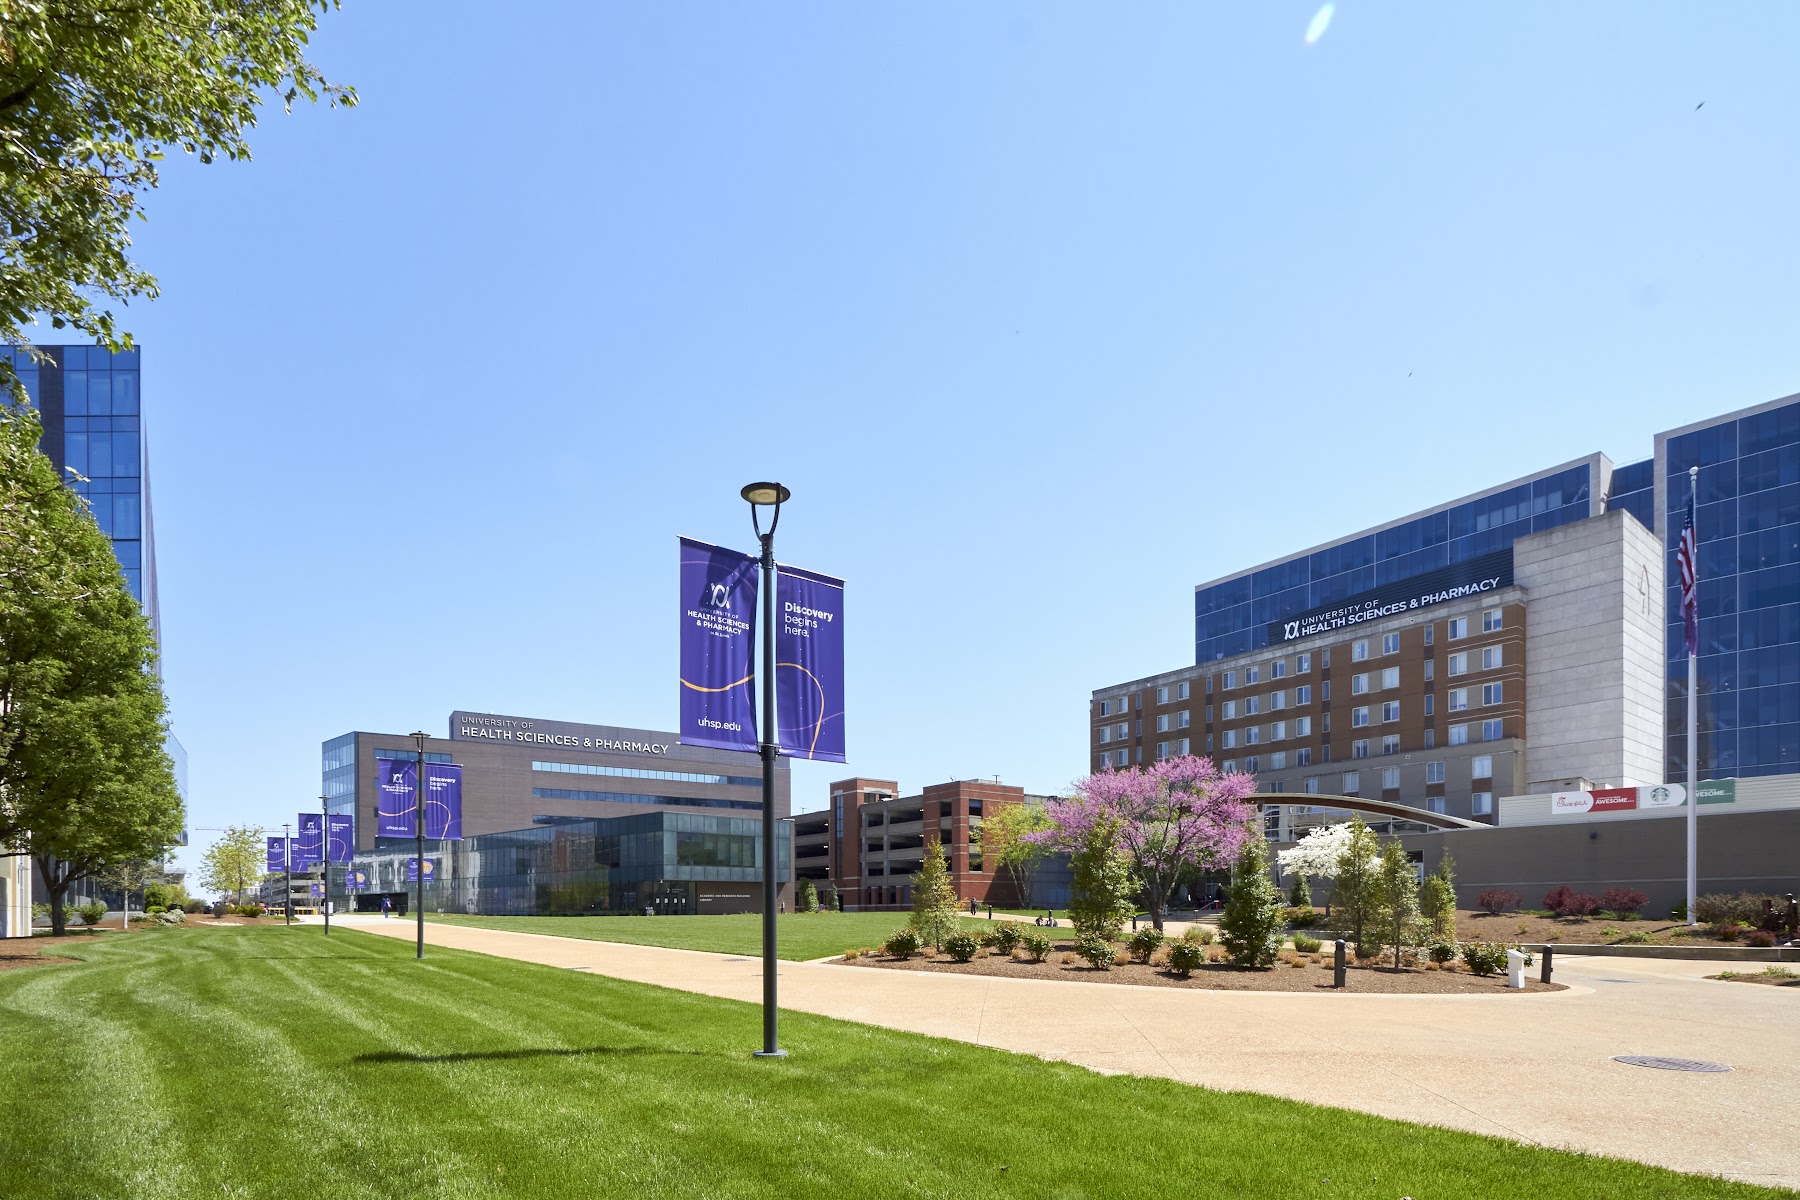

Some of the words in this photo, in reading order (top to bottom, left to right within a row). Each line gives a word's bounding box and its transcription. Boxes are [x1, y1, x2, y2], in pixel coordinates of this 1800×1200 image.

[784, 601, 834, 623] Discovery
[1301, 618, 1347, 637] HEALTH
[1347, 601, 1407, 625] SCIENCES
[1409, 598, 1420, 610] &
[1421, 576, 1501, 608] PHARMACY
[1301, 604, 1362, 626] UNIVERSITY
[1364, 599, 1380, 610] OF
[687, 609, 716, 622] HEALTH
[717, 616, 750, 630] SCIENCES
[696, 619, 702, 627] &
[703, 621, 742, 636] PHARMACY
[784, 613, 818, 629] begins
[784, 624, 810, 638] here.
[461, 716, 518, 728] UNIVERSITY
[521, 721, 534, 729] OF
[697, 717, 742, 732] uhsp.edu
[461, 727, 512, 741] HEALTH
[516, 731, 579, 747] SCIENCES
[583, 738, 592, 748] &
[595, 739, 669, 755] PHARMACY
